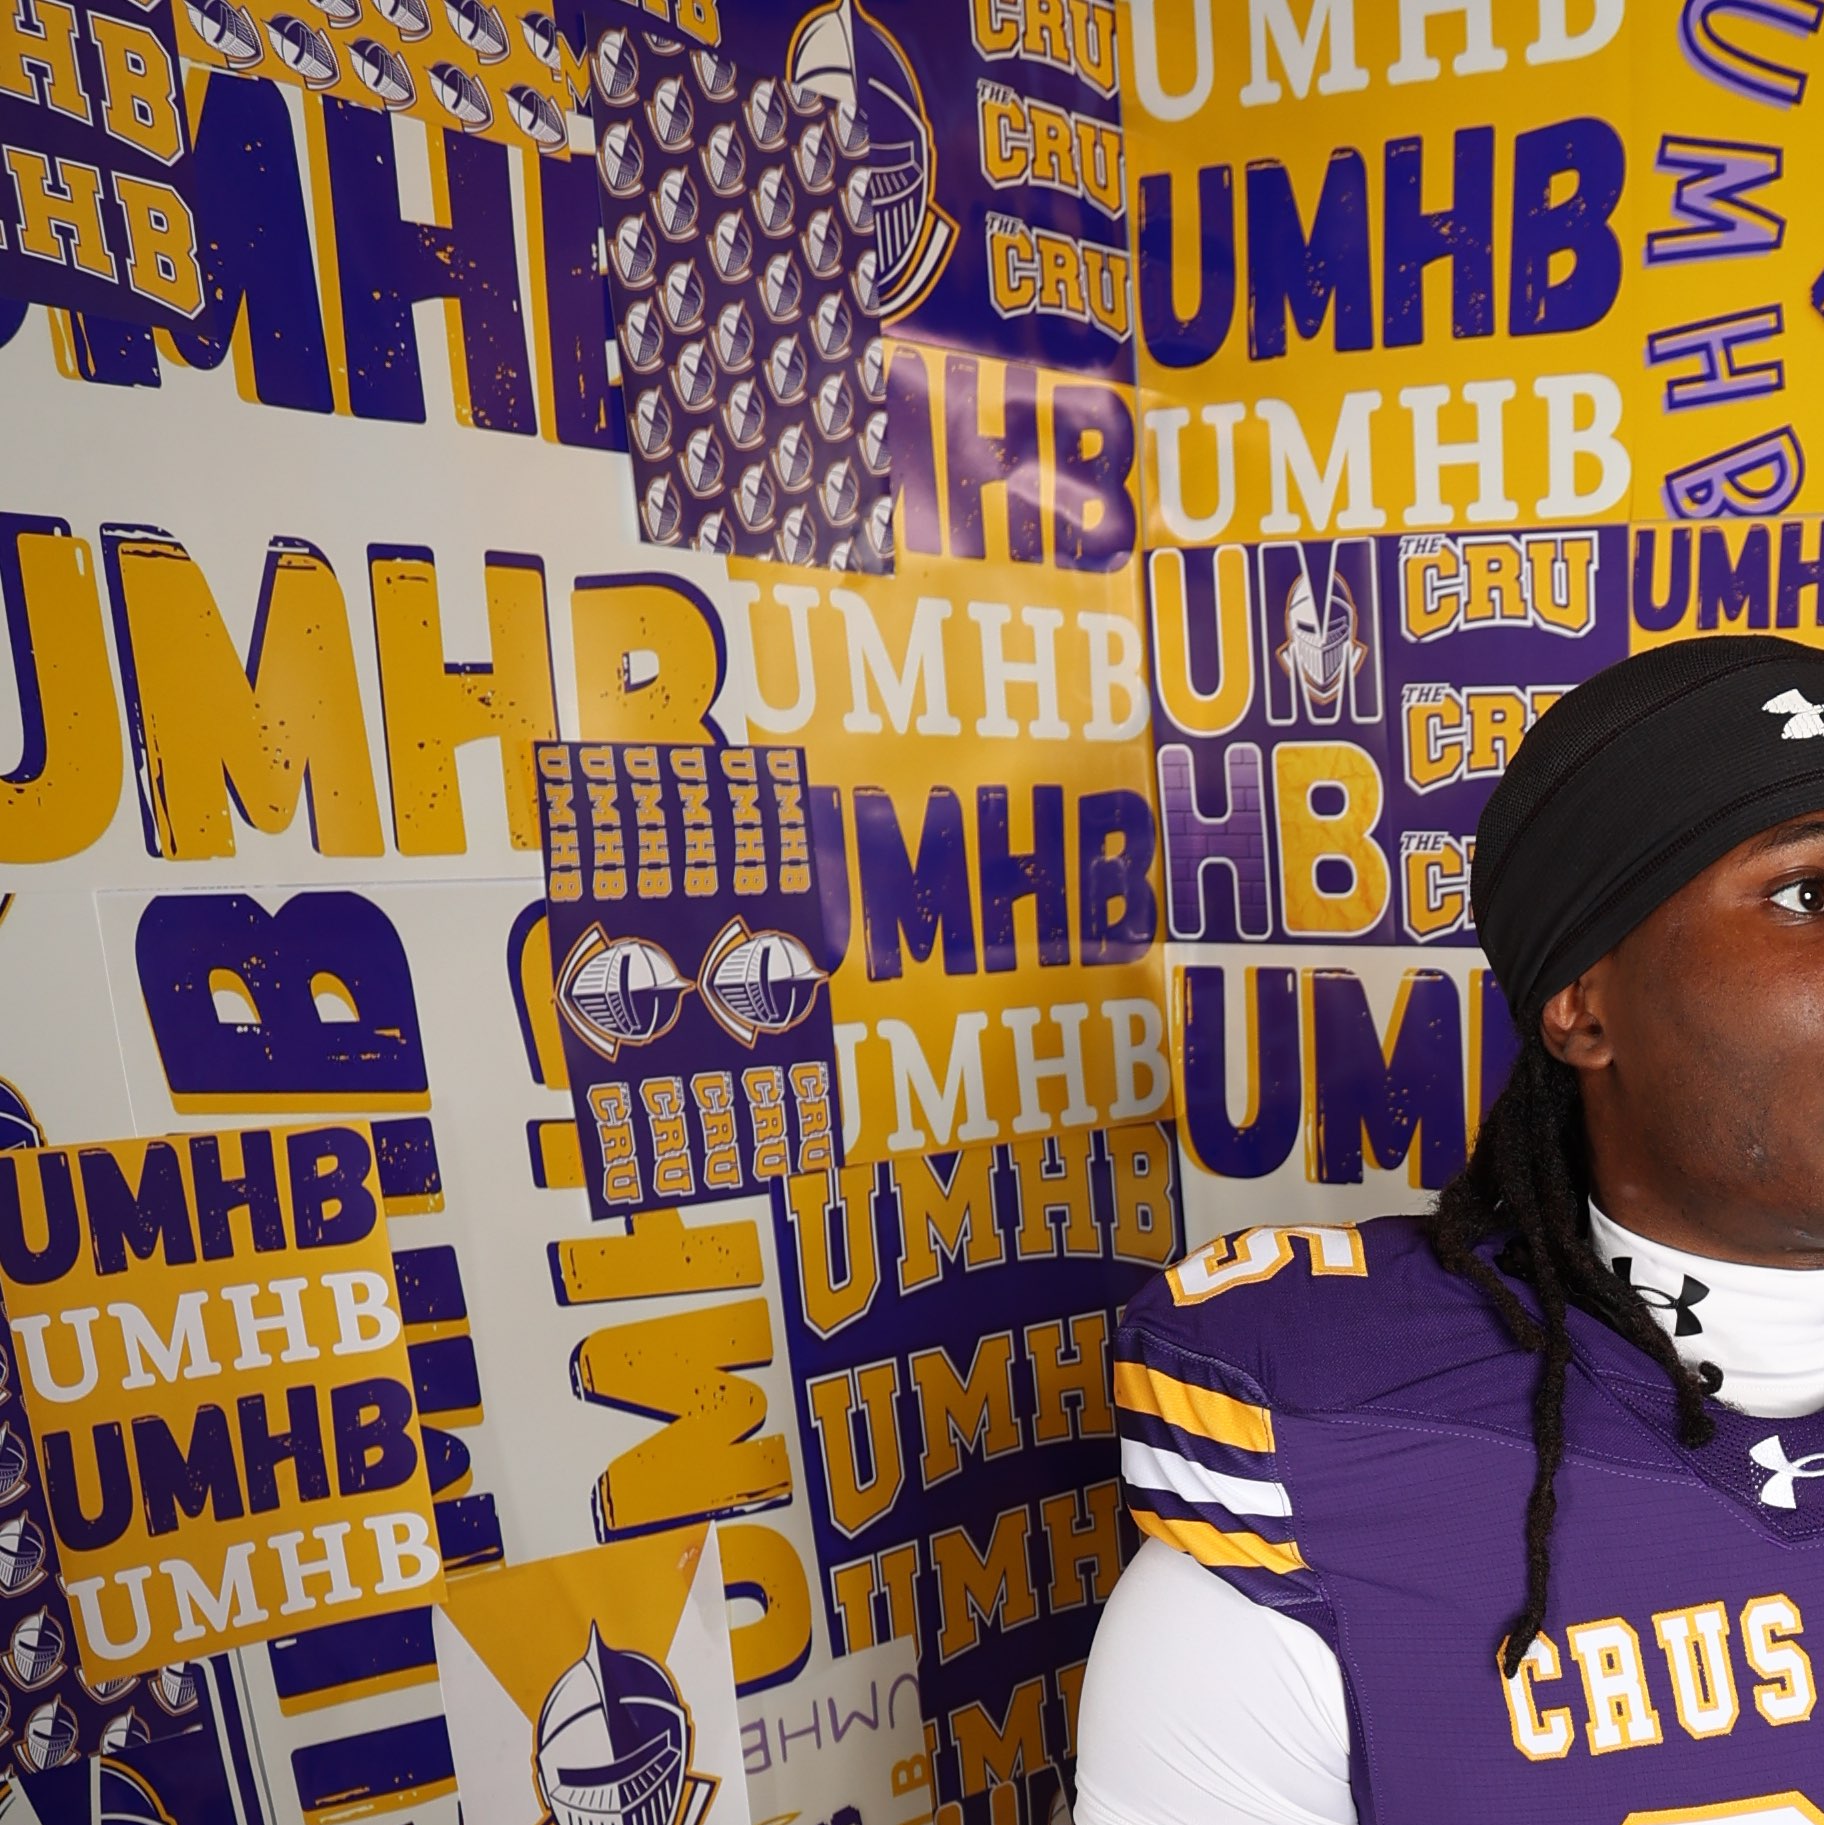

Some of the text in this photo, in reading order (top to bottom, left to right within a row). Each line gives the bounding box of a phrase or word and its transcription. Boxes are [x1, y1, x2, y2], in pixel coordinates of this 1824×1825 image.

[0, 143, 205, 319] HB
[977, 94, 1126, 220] CRU
[986, 229, 1132, 342] CRU
[1138, 116, 1627, 368] UMHB
[1143, 373, 1633, 541] UMHB
[729, 577, 1151, 742] UMHB
[1399, 530, 1601, 644] THE CRU
[1400, 682, 1580, 797] THE CR
[538, 746, 584, 902] UMHB
[580, 746, 628, 900] UMHB
[623, 747, 672, 899] UMHB
[670, 747, 719, 897] UMHB
[720, 748, 768, 896] UMHB
[767, 749, 811, 894] UMHB
[587, 1084, 643, 1204] CRU
[640, 1077, 695, 1196] CRU
[690, 1072, 743, 1189] CRU
[741, 1067, 791, 1182] CRU
[789, 1063, 835, 1172] CRU
[0, 1125, 378, 1286] UMHB
[782, 1127, 1176, 1340] UMHB
[11, 1270, 401, 1404] UMHB
[44, 1376, 420, 1551] UMHB
[805, 1311, 1121, 1539] UMH
[67, 1510, 442, 1661] UMHB
